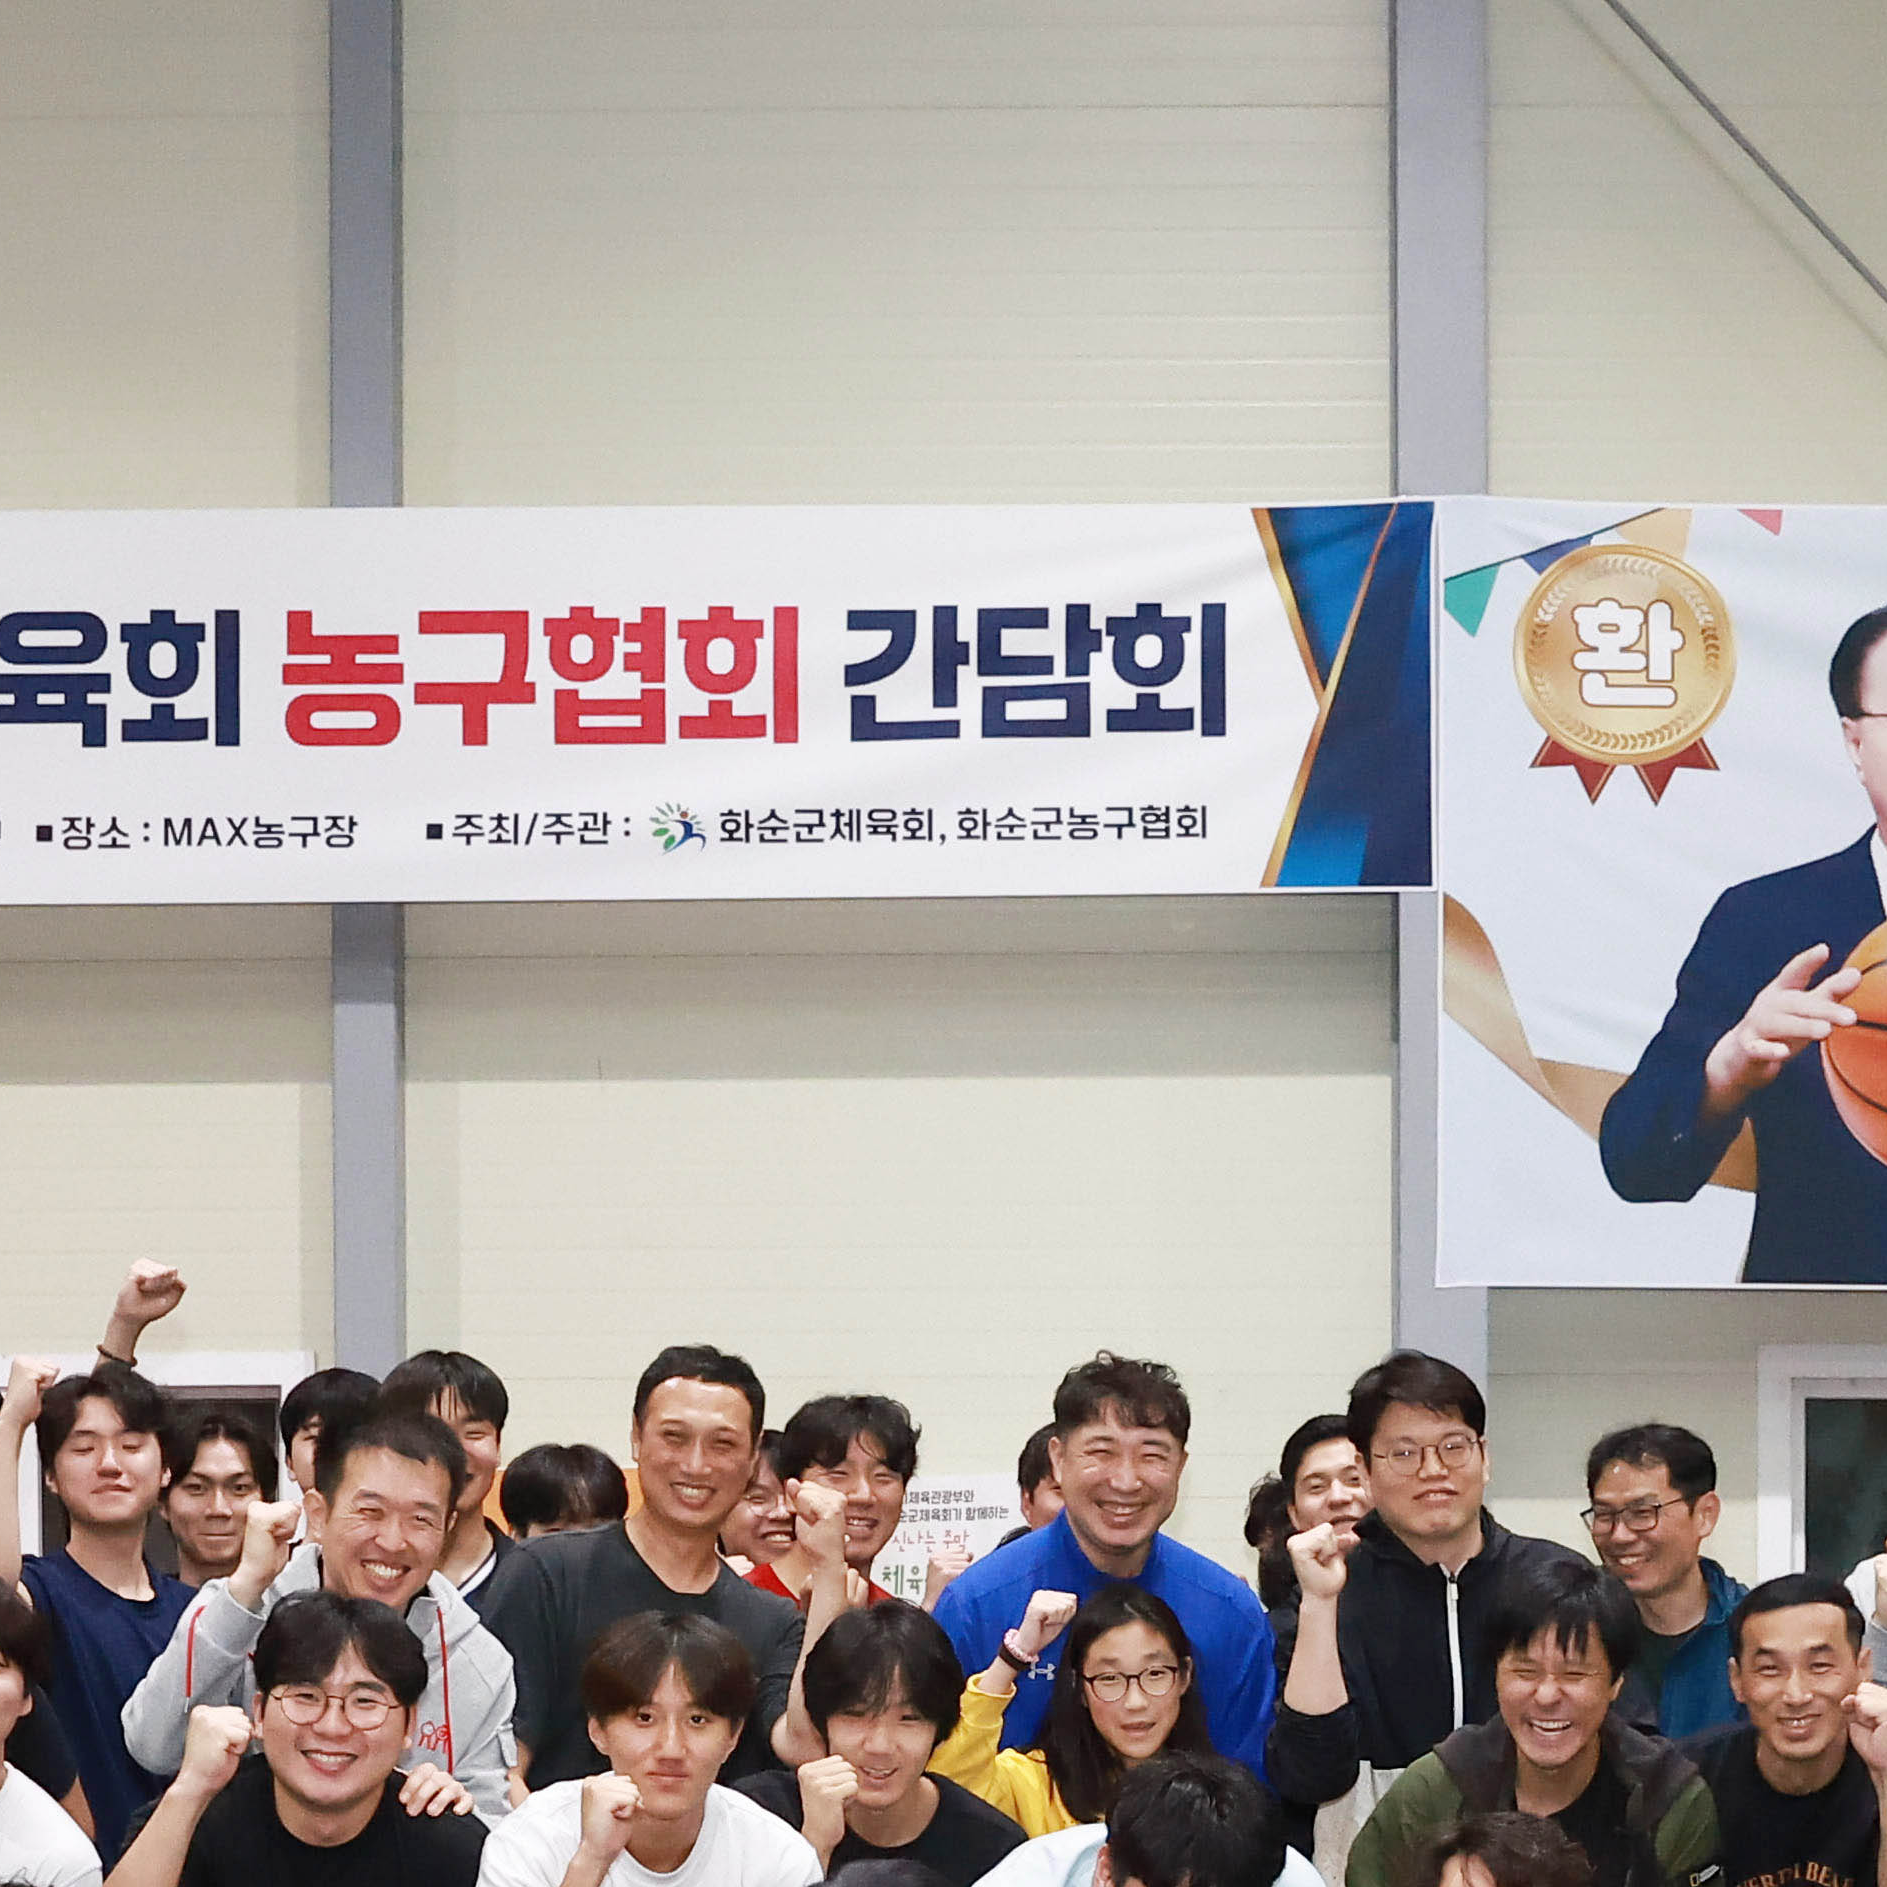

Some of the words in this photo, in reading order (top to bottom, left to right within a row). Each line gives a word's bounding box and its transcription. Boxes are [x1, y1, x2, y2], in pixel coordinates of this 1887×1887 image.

[282, 606, 798, 746] 농구협회
[844, 603, 1226, 742] 간담회
[1572, 598, 1685, 708] 환
[62, 816, 130, 850] 장소
[164, 815, 358, 850] MAX농구장
[452, 811, 613, 847] 주최/주관
[719, 806, 947, 846] 화순군체육회,
[957, 804, 1207, 843] 화순군농구협회
[905, 1489, 974, 1504] 체육관광부와
